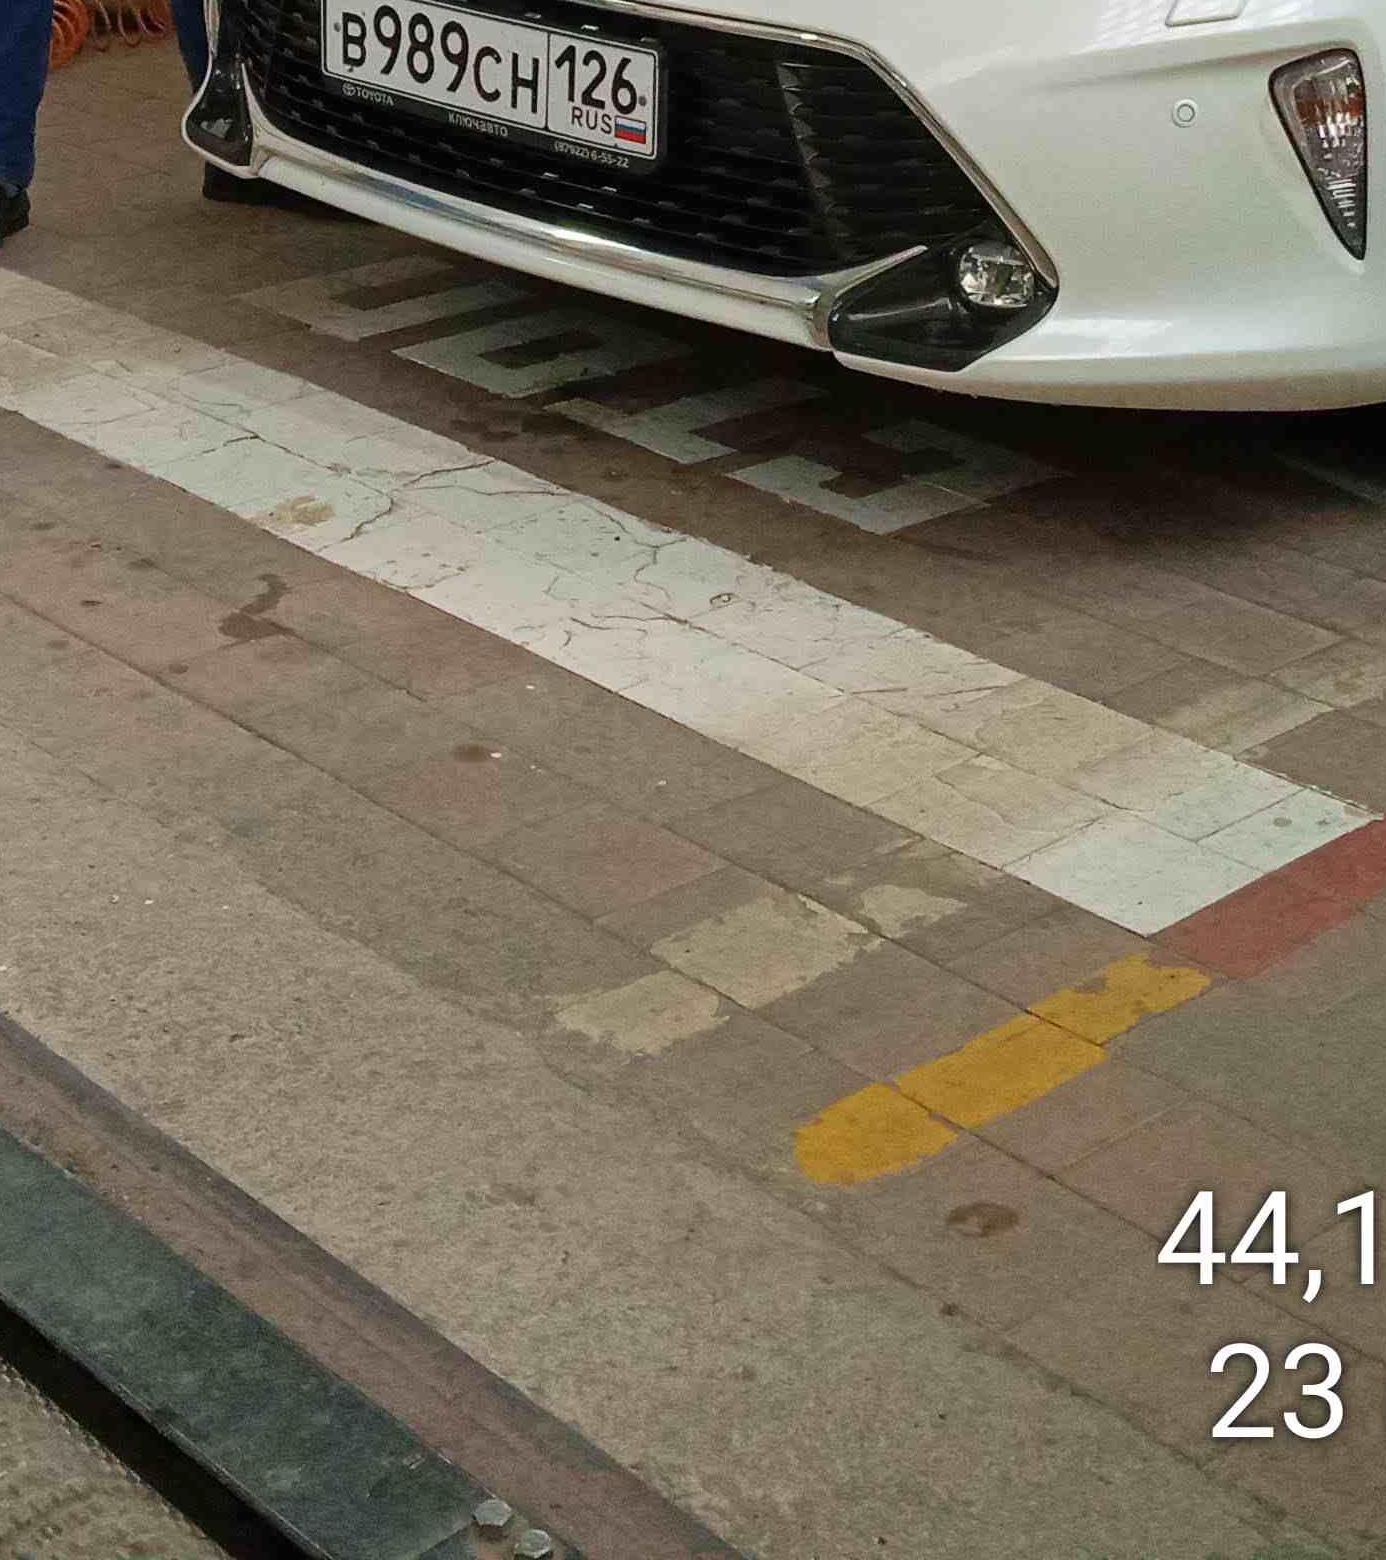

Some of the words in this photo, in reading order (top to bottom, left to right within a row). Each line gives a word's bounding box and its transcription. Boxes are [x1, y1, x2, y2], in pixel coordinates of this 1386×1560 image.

[341, 4, 540, 114] В989СН
[554, 43, 638, 115] 126
[355, 88, 395, 107] TOYOTA
[571, 106, 613, 135] RUS
